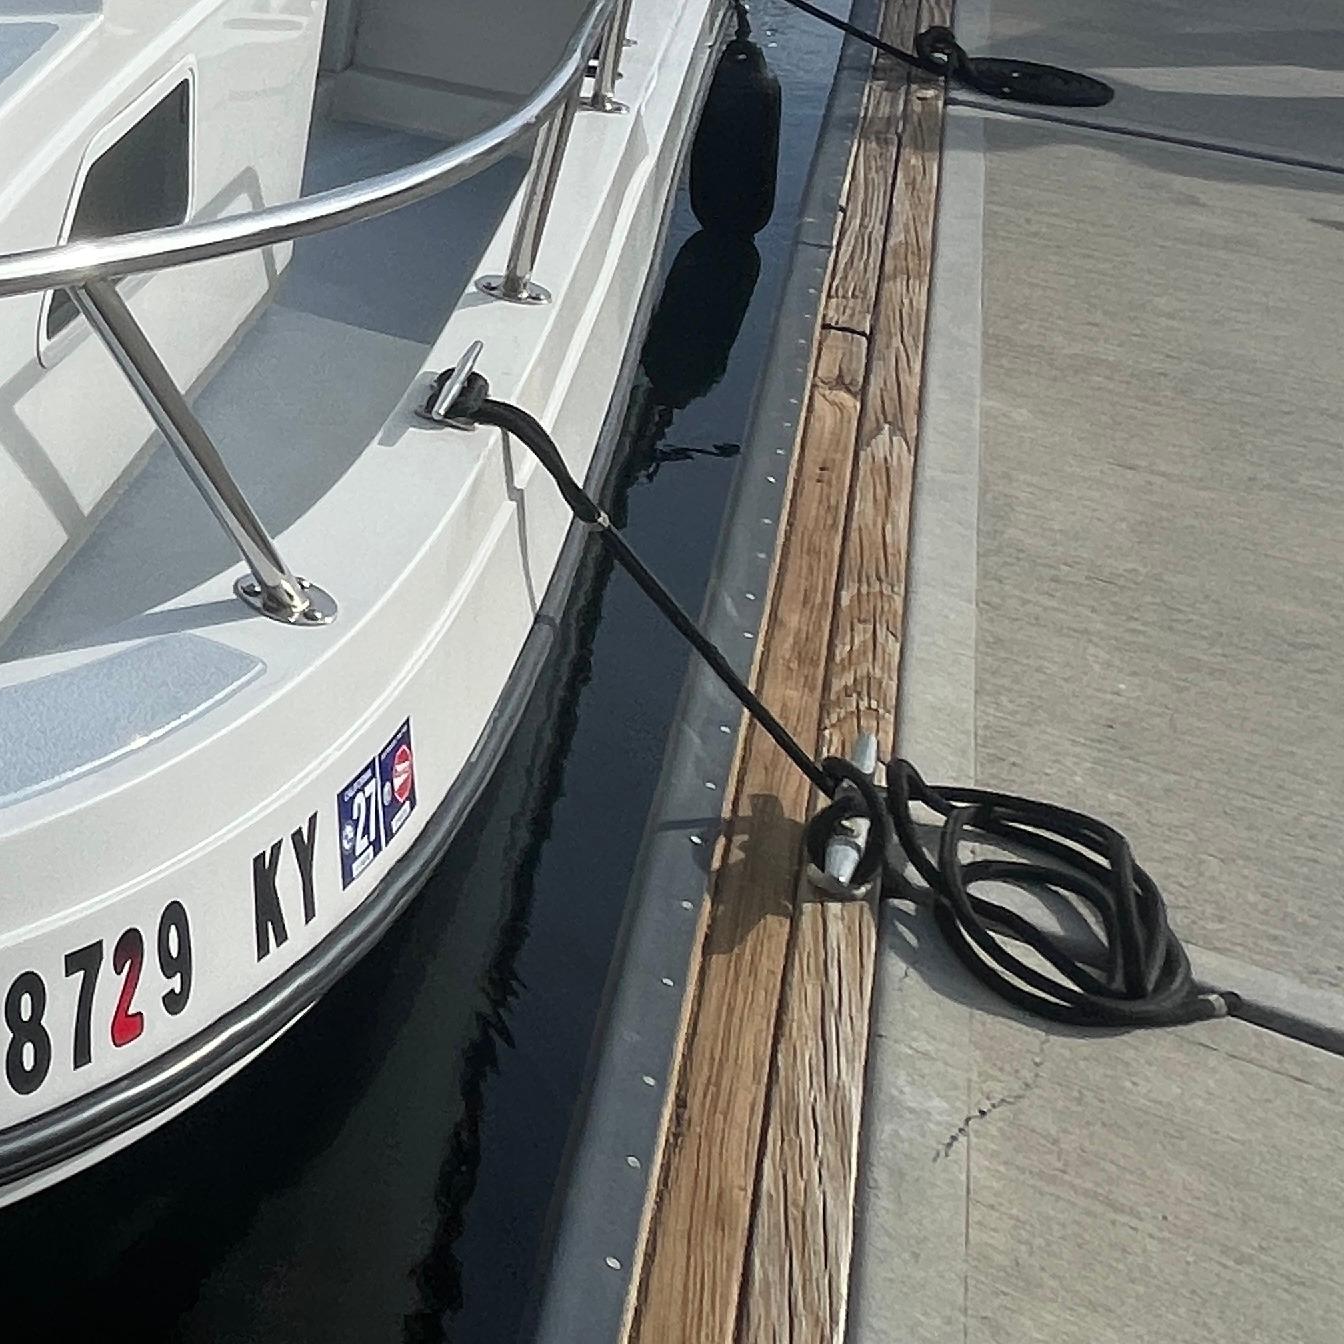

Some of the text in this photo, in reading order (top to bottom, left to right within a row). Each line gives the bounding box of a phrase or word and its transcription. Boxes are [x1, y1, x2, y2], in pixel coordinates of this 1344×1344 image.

[352, 777, 377, 857] 27
[4, 899, 193, 1095] 8729
[252, 811, 319, 962] KY
